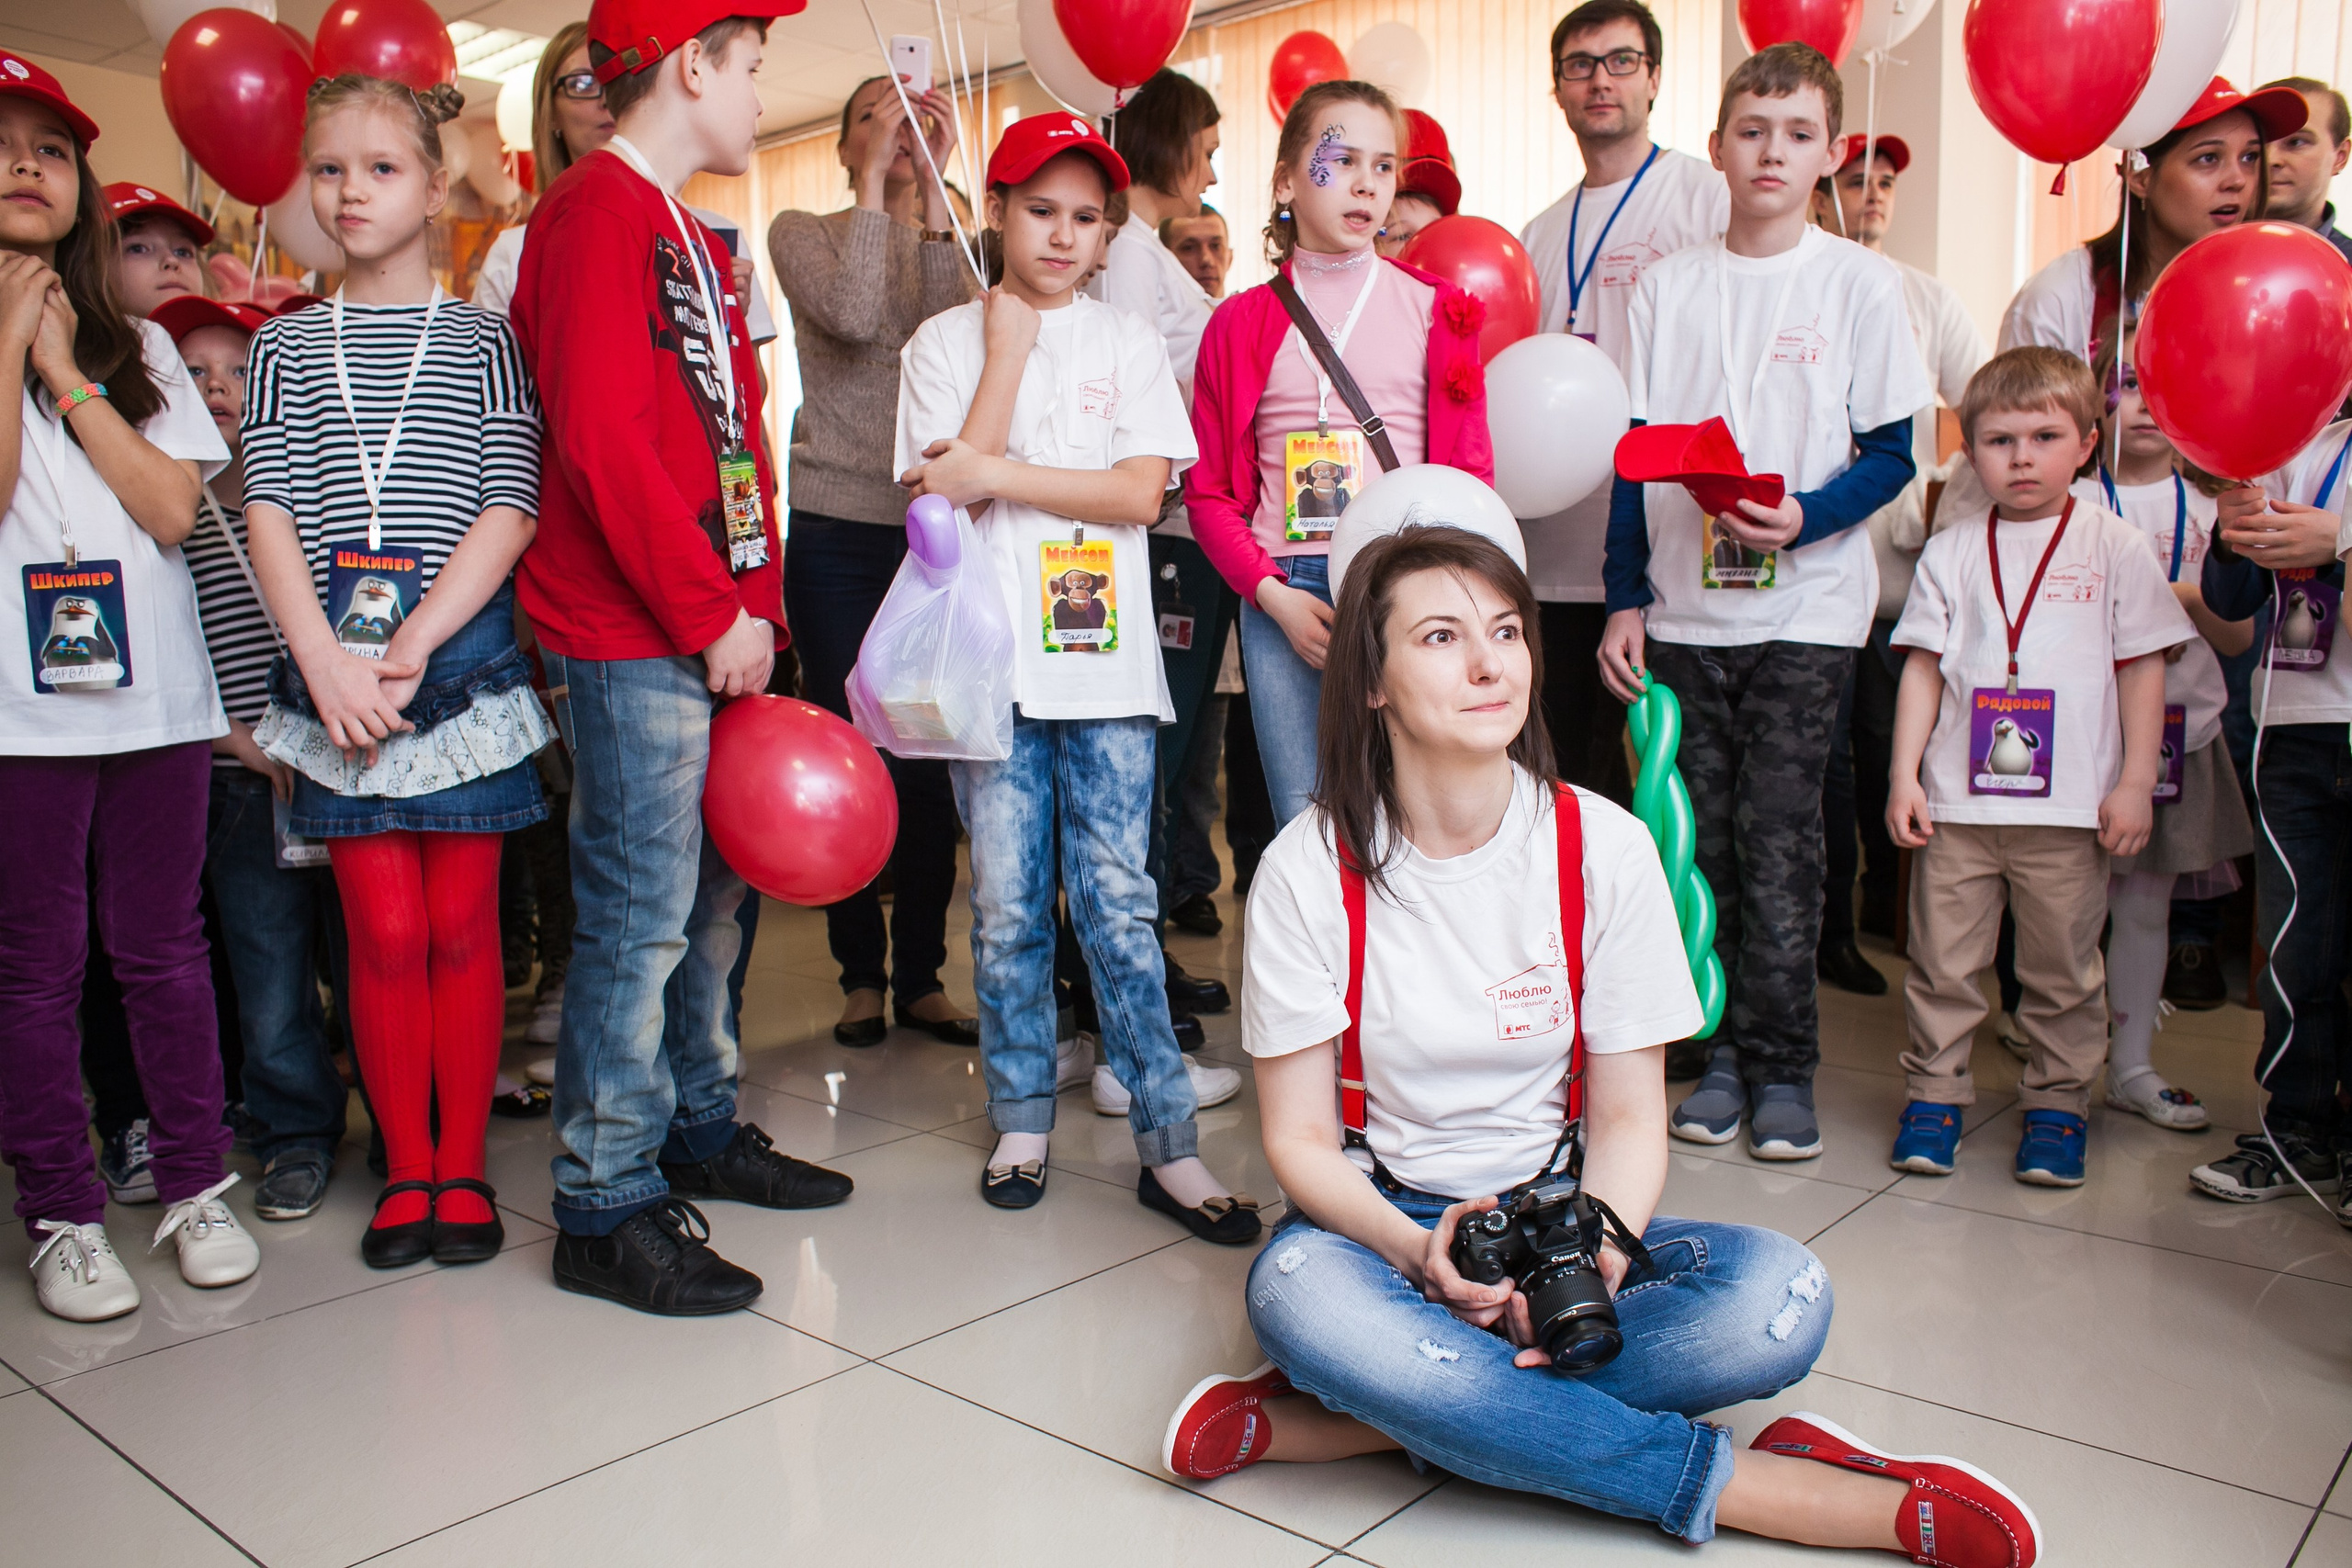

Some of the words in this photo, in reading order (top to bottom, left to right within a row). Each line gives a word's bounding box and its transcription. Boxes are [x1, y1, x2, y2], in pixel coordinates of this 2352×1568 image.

[1498, 985, 1552, 1001] Люблю
[1521, 998, 1548, 1009] семью!
[1551, 1250, 1581, 1263] Canon
